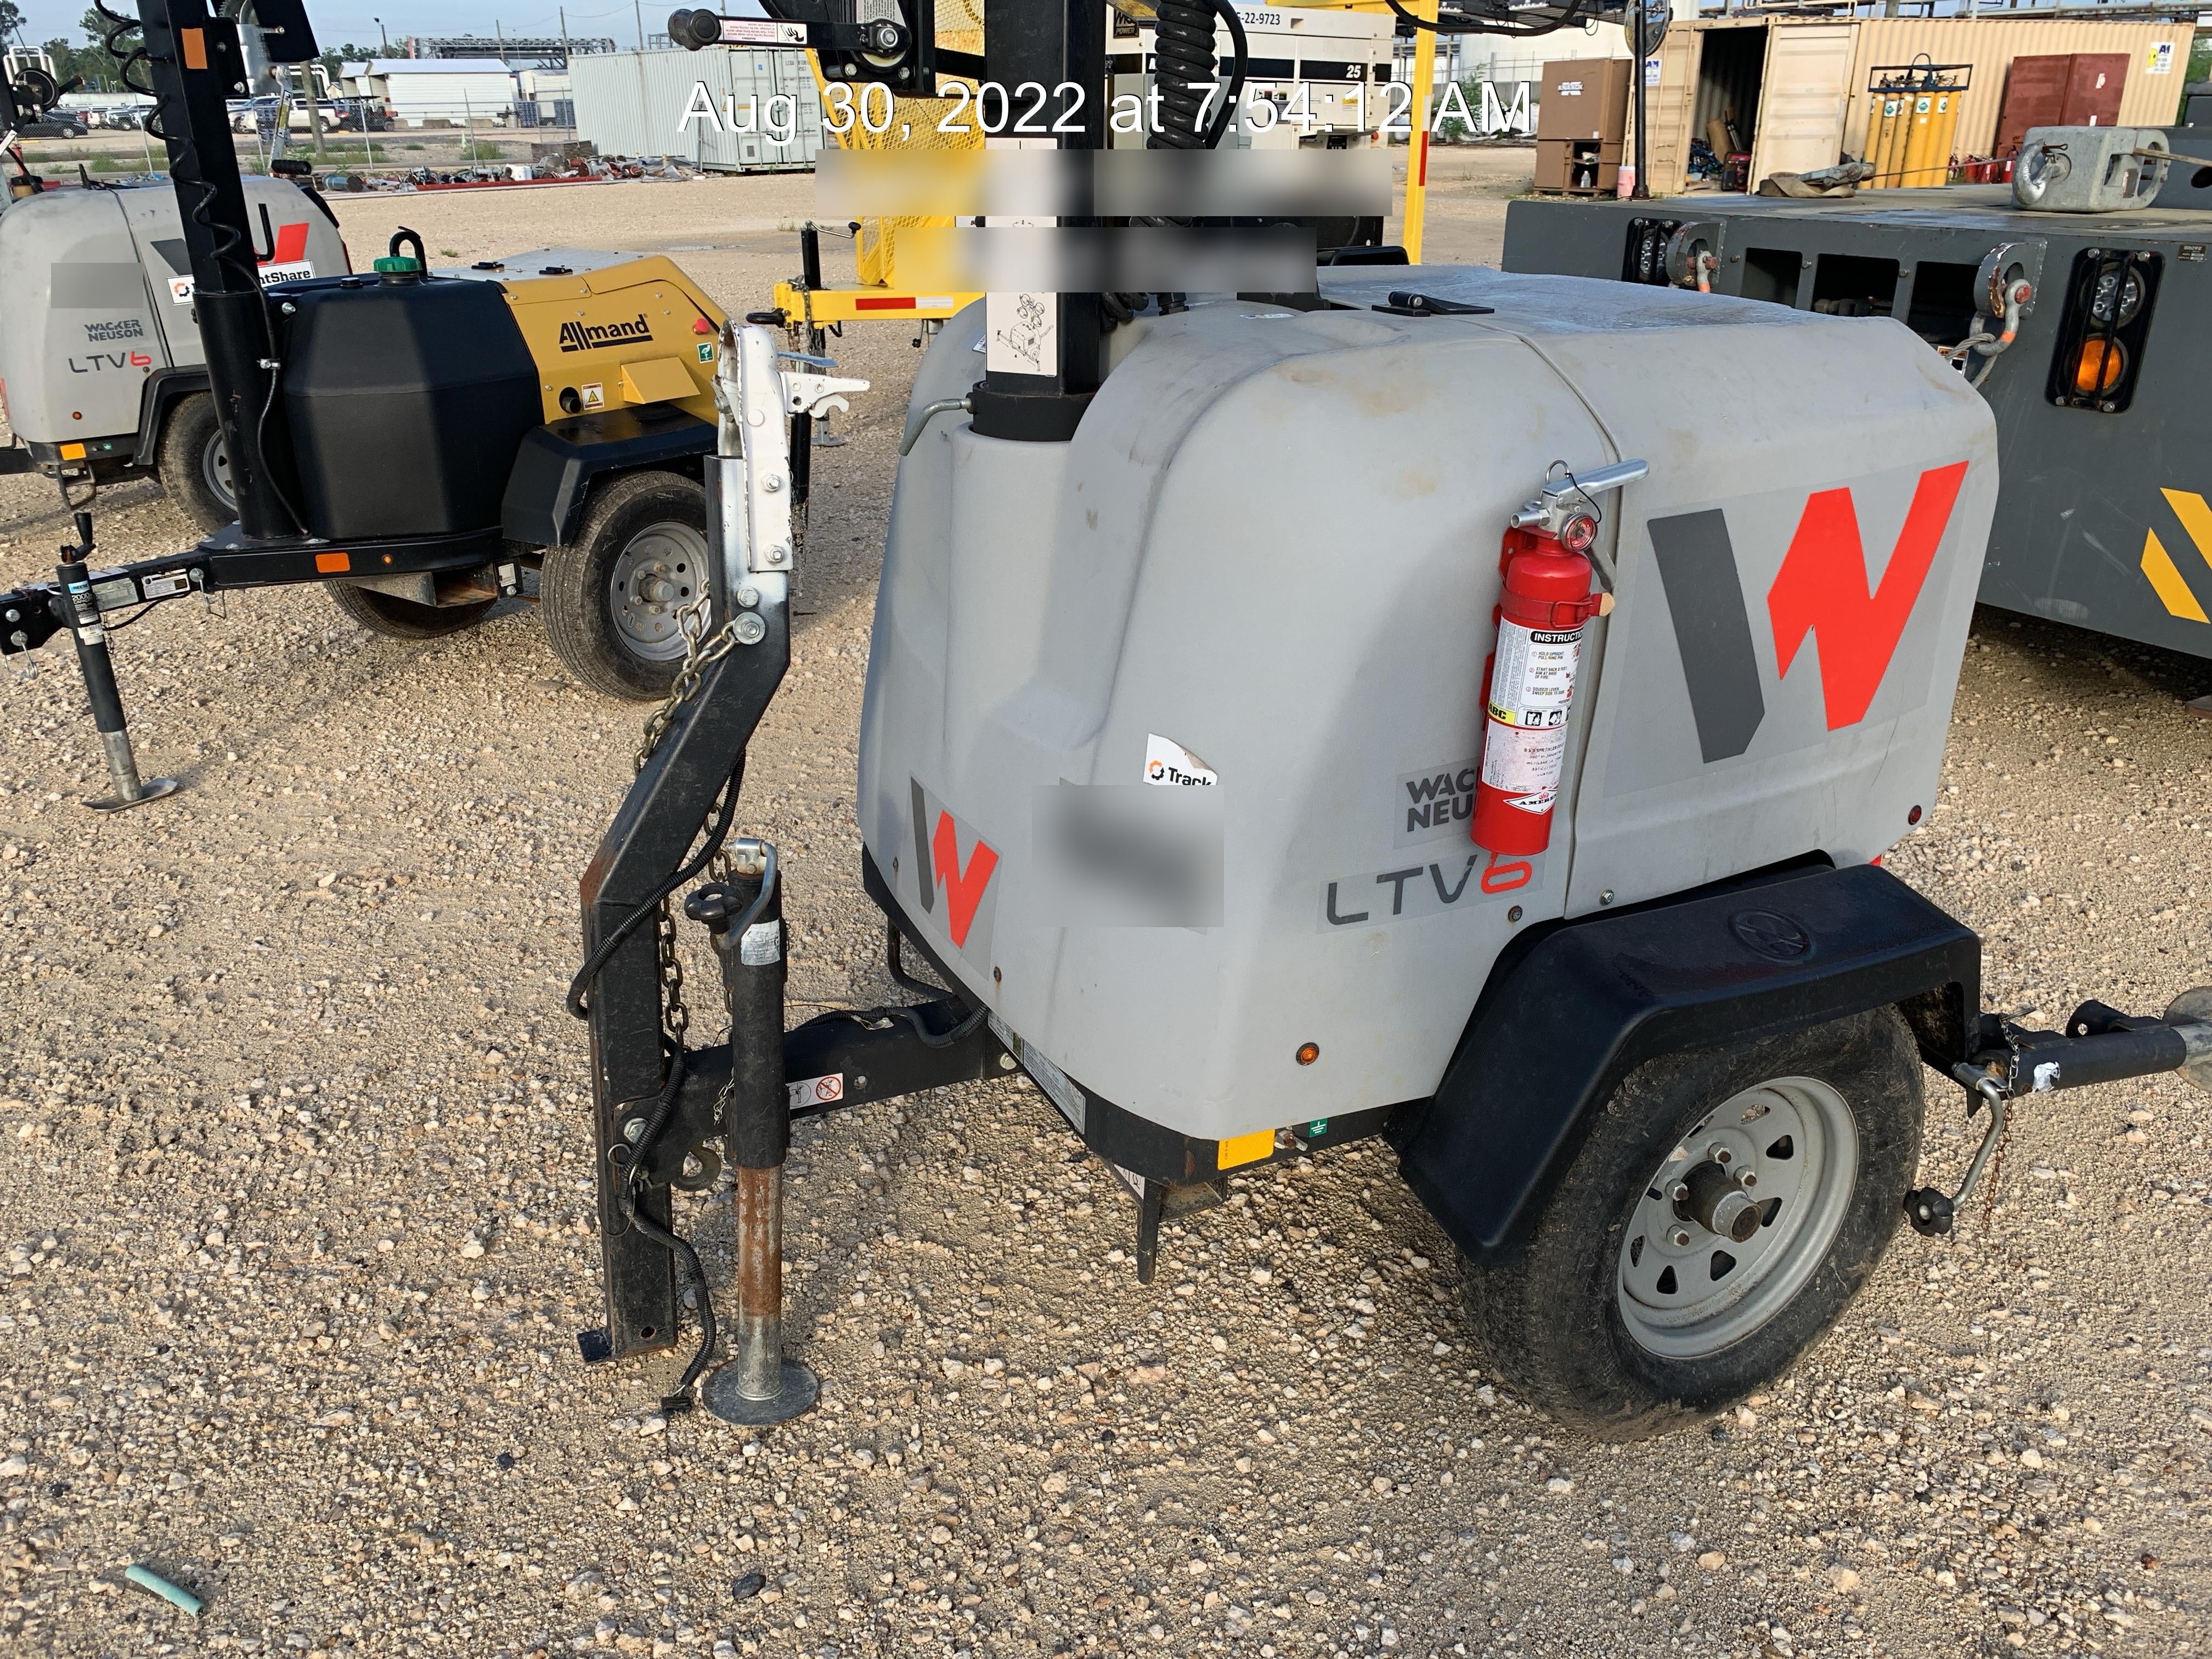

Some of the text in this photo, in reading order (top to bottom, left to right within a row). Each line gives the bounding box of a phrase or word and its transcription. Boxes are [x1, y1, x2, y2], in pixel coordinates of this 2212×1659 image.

[1346, 65, 1362, 78] 25
[84, 319, 142, 332] WACKER
[559, 314, 650, 350] Allmand
[88, 328, 144, 342] NEUSON
[68, 351, 152, 374] LTV6
[1488, 703, 1506, 720] ABC
[1327, 852, 1533, 926] LTV6
